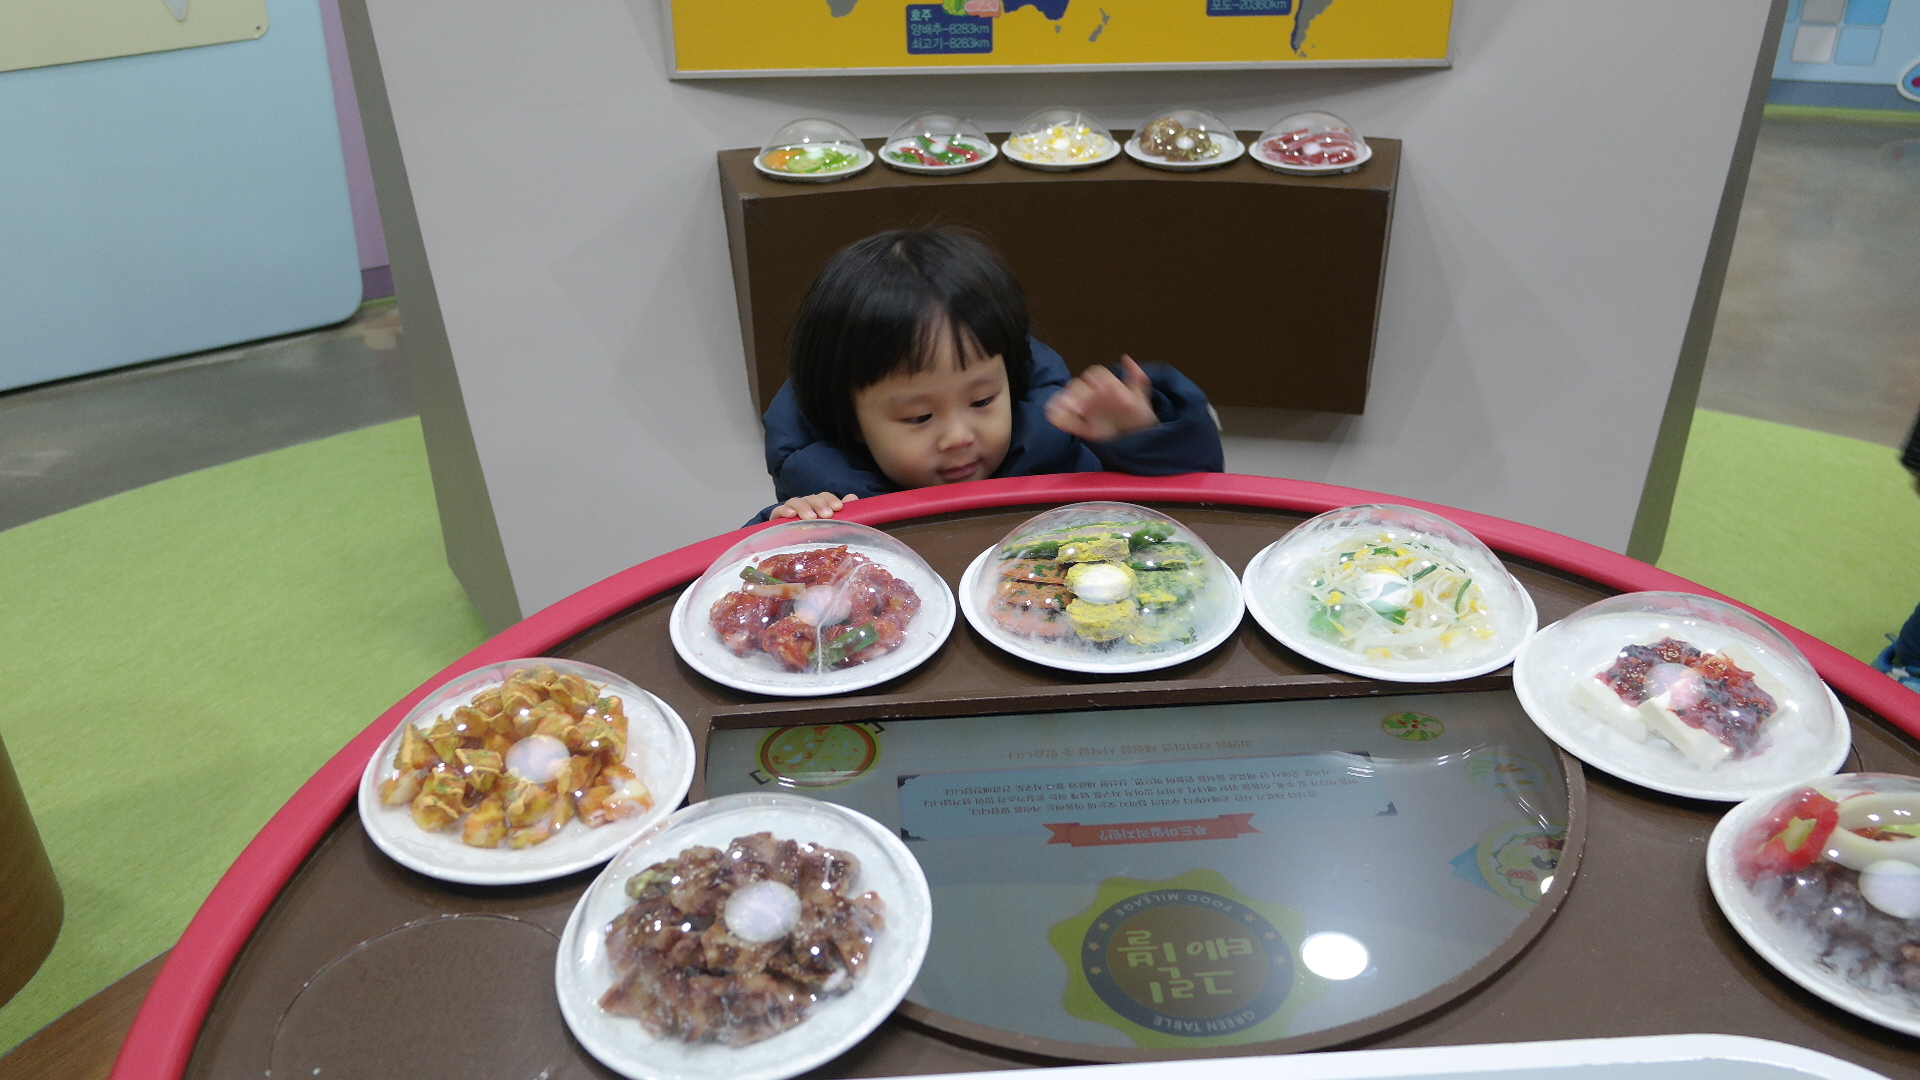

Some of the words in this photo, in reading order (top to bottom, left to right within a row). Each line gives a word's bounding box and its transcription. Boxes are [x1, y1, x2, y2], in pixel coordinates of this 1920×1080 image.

[910, 8, 932, 22] 호주
[1100, 825, 1207, 840] 푸드마일리지란?
[1114, 892, 1179, 917] MILEAGE
[1187, 893, 1232, 912] FOOD
[1117, 929, 1253, 968] 테이블
[1149, 966, 1235, 1004] 그린
[1152, 1015, 1200, 1033] TABLE
[1205, 1010, 1256, 1032] GREEN
